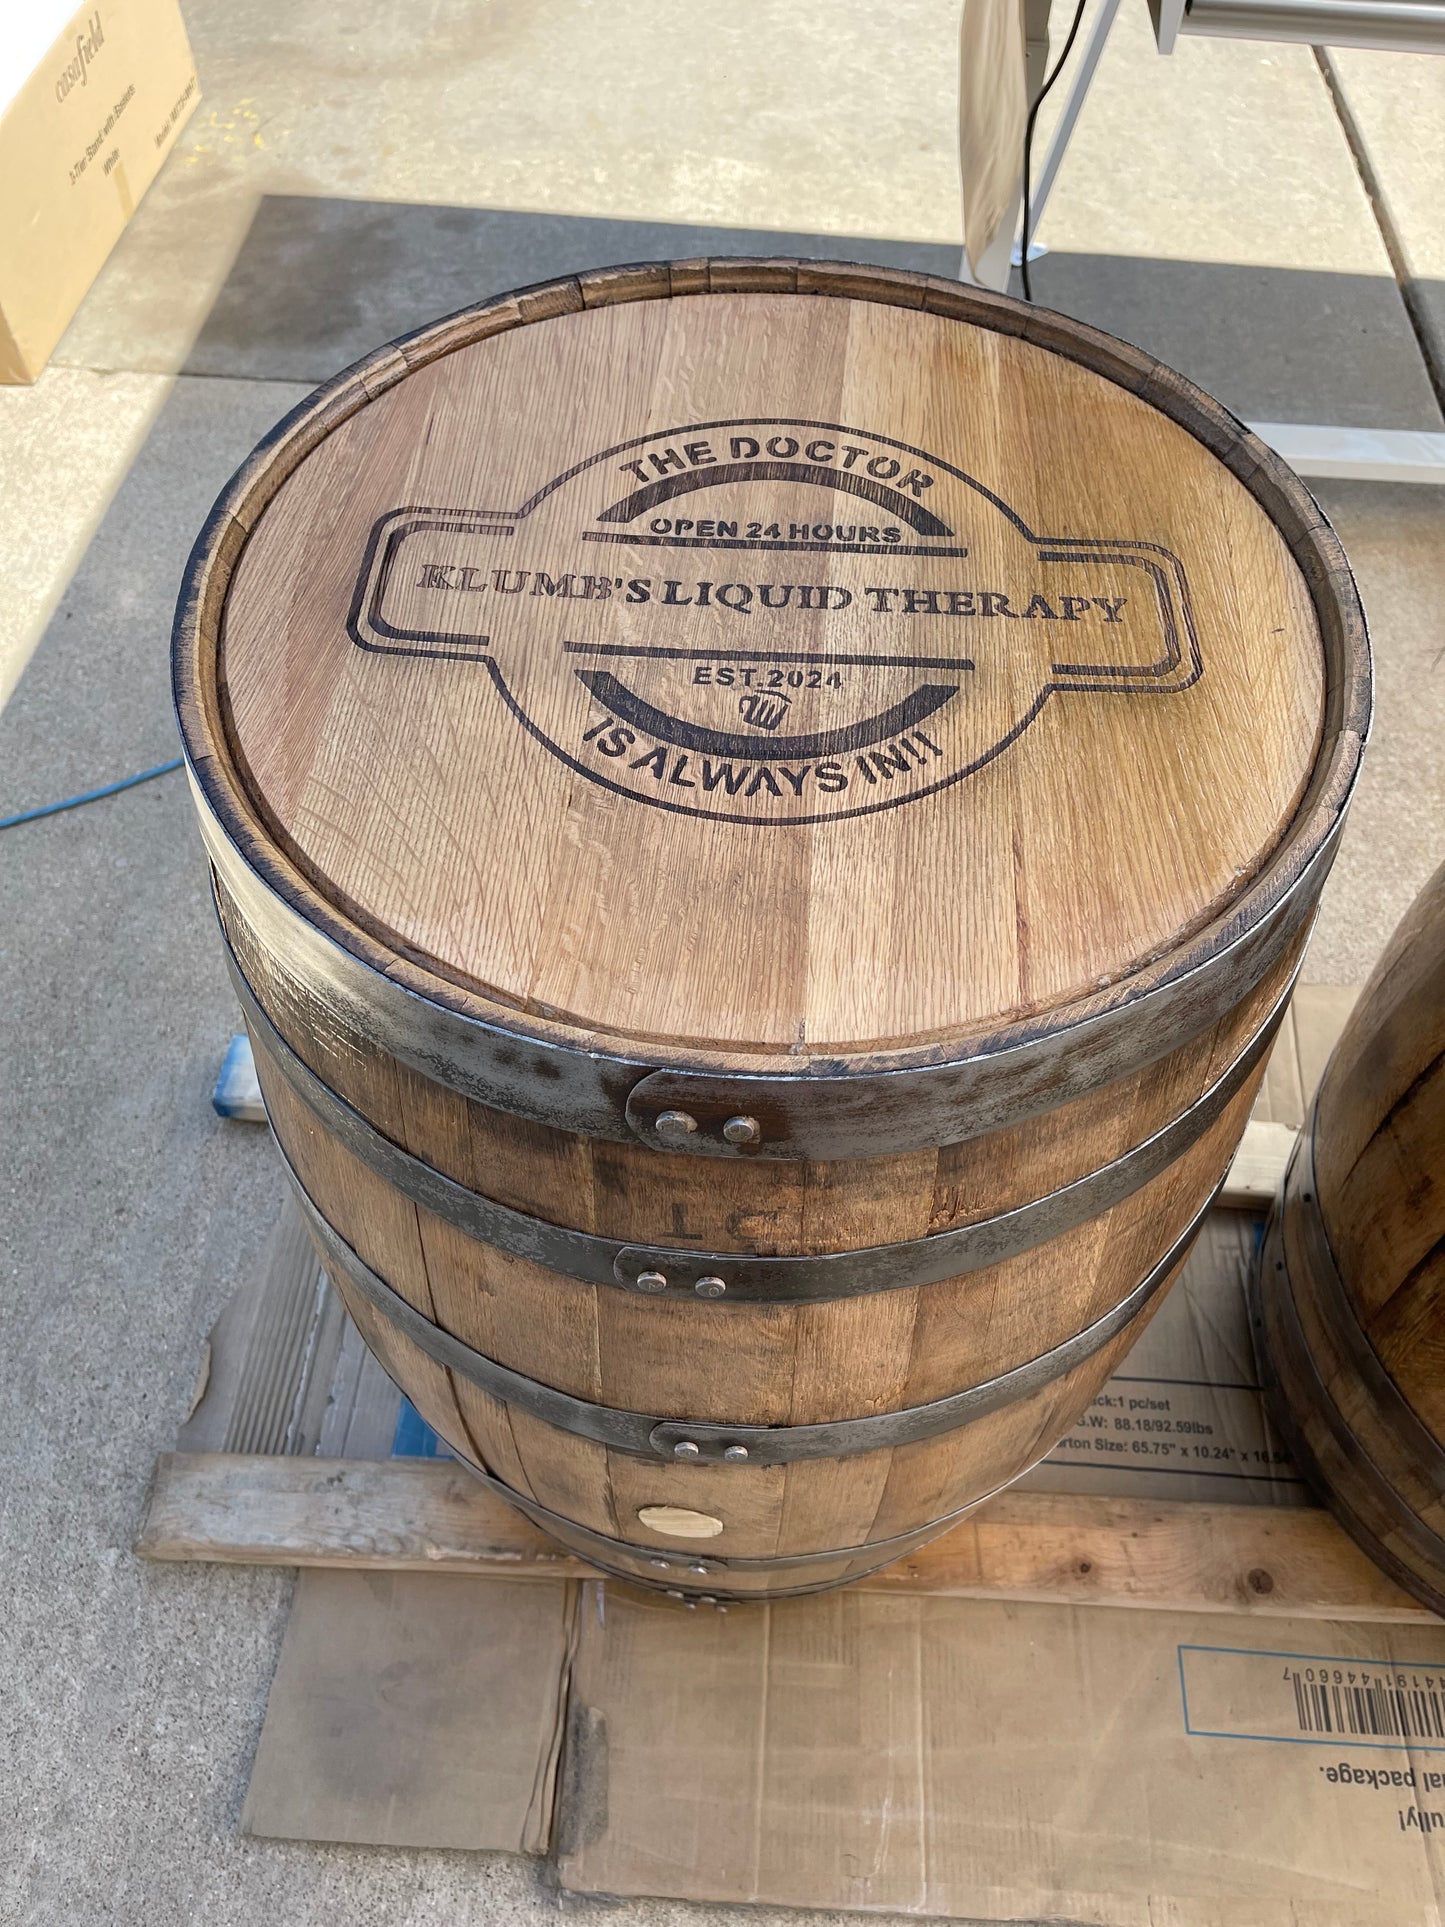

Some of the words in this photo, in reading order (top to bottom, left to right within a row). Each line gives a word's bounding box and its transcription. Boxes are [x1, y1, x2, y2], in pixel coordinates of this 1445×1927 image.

[619, 440, 718, 485] THE
[730, 435, 935, 498] DOCTOR
[649, 518, 739, 539] OPEN
[745, 521, 782, 540] 24
[788, 523, 902, 544] HOURS
[416, 563, 652, 604] KLUMB'S
[660, 579, 853, 615] LIQUID
[864, 586, 1129, 623] THERAPY
[582, 716, 637, 758] IS
[628, 746, 849, 798] ALWAYS
[855, 730, 944, 785] IN!!
[1129, 1397, 1171, 1412] pc/set
[1057, 1437, 1092, 1450] arton
[1094, 1438, 1128, 1453] Size:
[1180, 1447, 1190, 1458] x
[1305, 1667, 1371, 1686] 44660
[1319, 1762, 1417, 1790] package.
[1398, 1806, 1445, 1833] ully!
